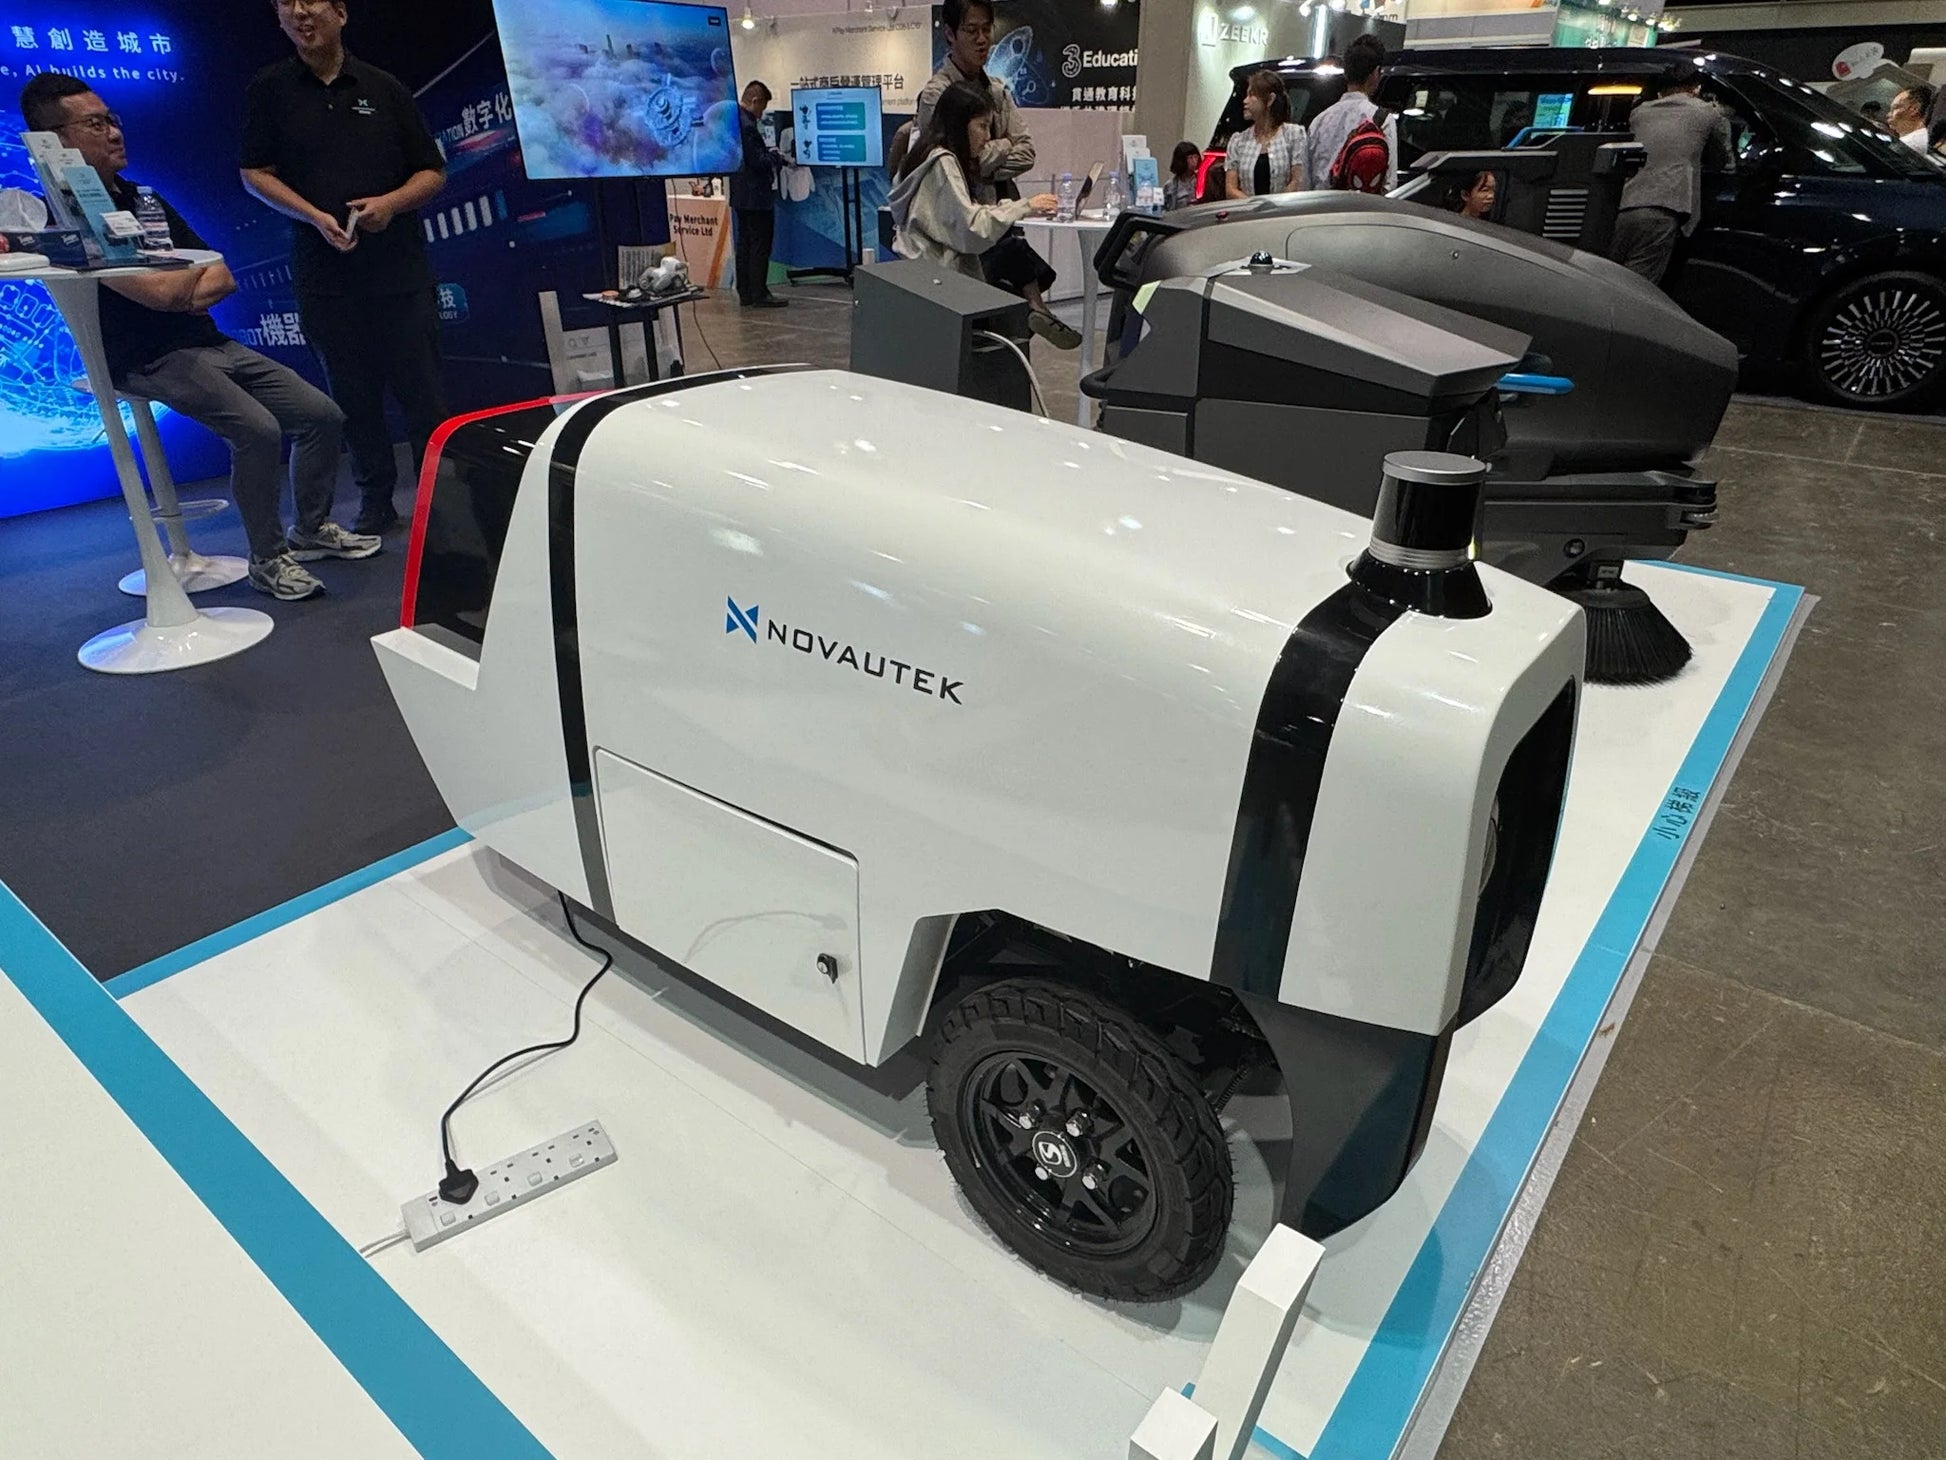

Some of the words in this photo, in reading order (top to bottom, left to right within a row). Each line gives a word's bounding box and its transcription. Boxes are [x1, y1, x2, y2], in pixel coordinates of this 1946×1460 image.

[1219, 22, 1269, 47] ZEEKR
[112, 67, 141, 80] the
[147, 68, 185, 84] city.
[683, 214, 719, 227] Merchant
[673, 225, 700, 236] Service
[701, 226, 714, 237] Ltd
[767, 618, 965, 706] NOVAUTEK
